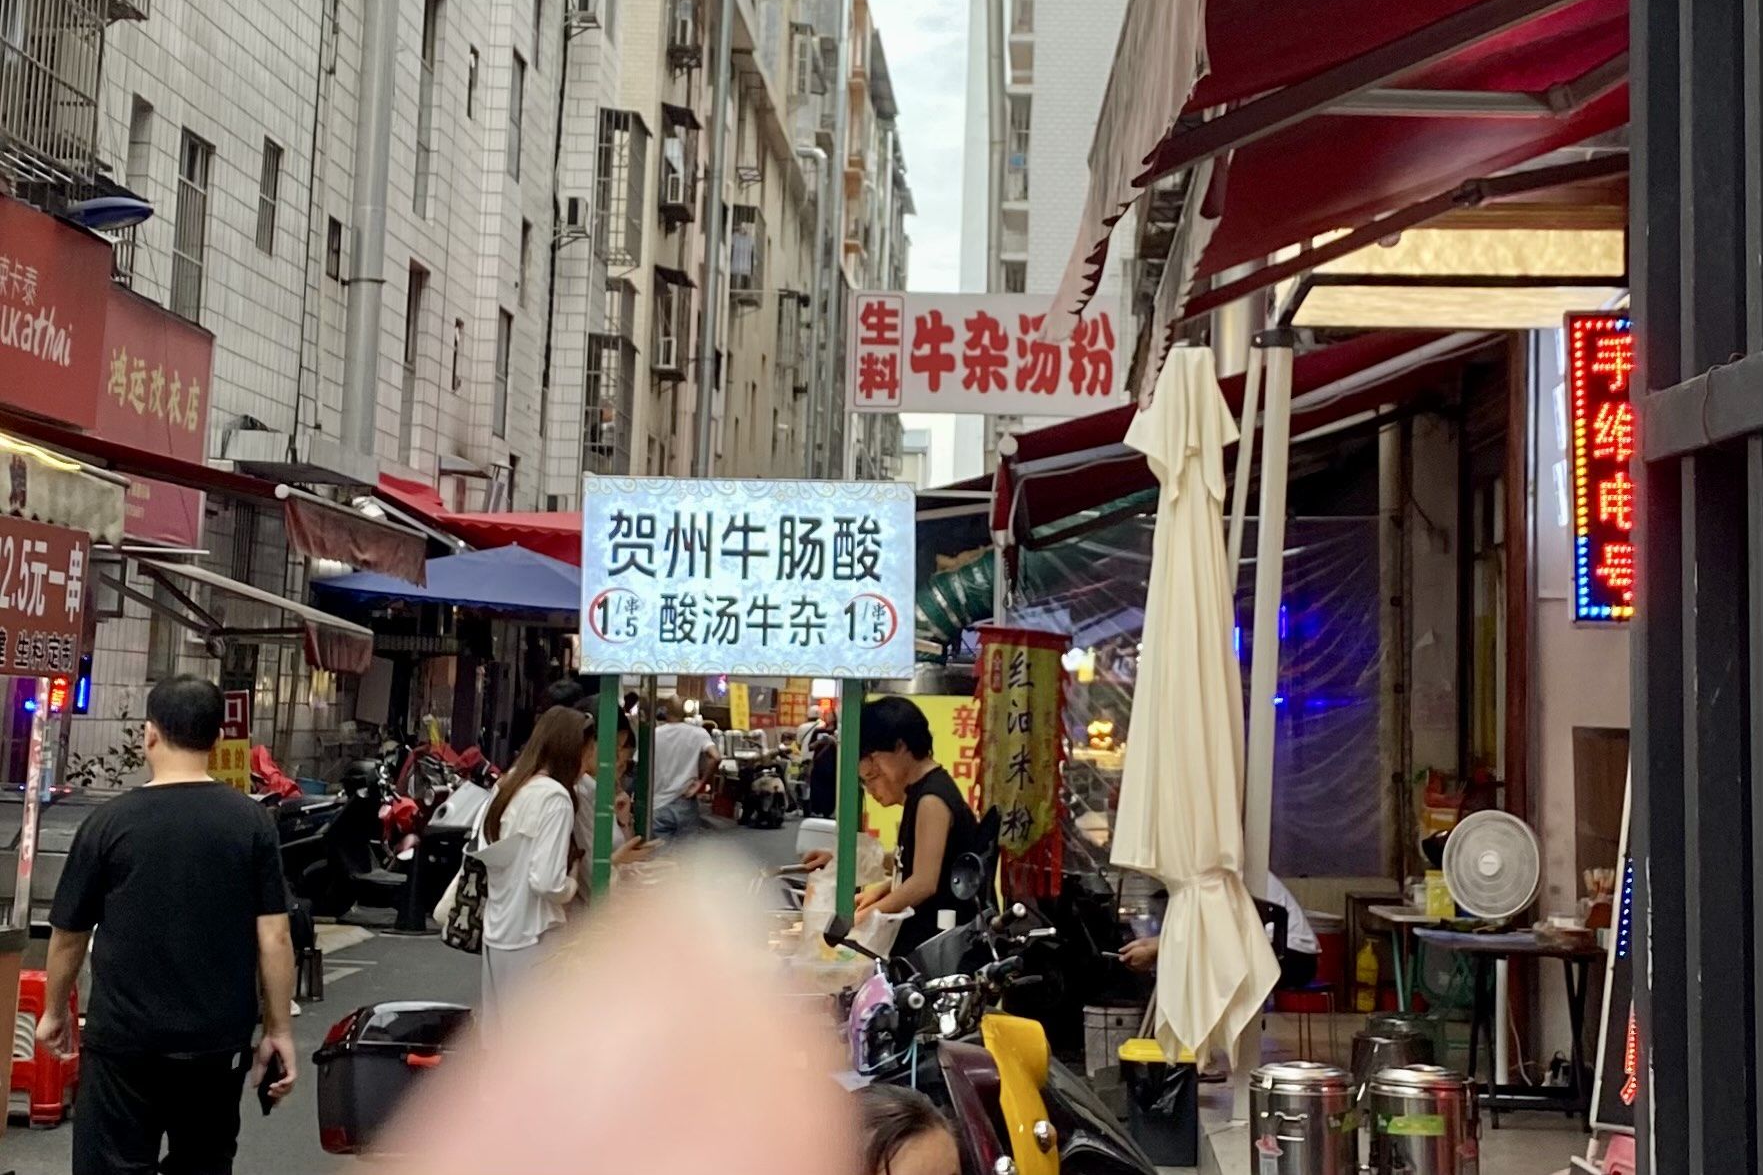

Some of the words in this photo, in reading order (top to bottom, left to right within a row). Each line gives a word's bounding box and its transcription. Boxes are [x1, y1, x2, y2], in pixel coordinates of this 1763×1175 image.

[107, 346, 201, 431] 鸿运改衣店
[860, 300, 900, 400] 生料
[910, 309, 1115, 397] 牛杂汤粉
[607, 509, 883, 582] 贺州牛肠酸
[658, 592, 828, 647] 酸汤牛杂
[1001, 650, 1036, 842] 红油米粉
